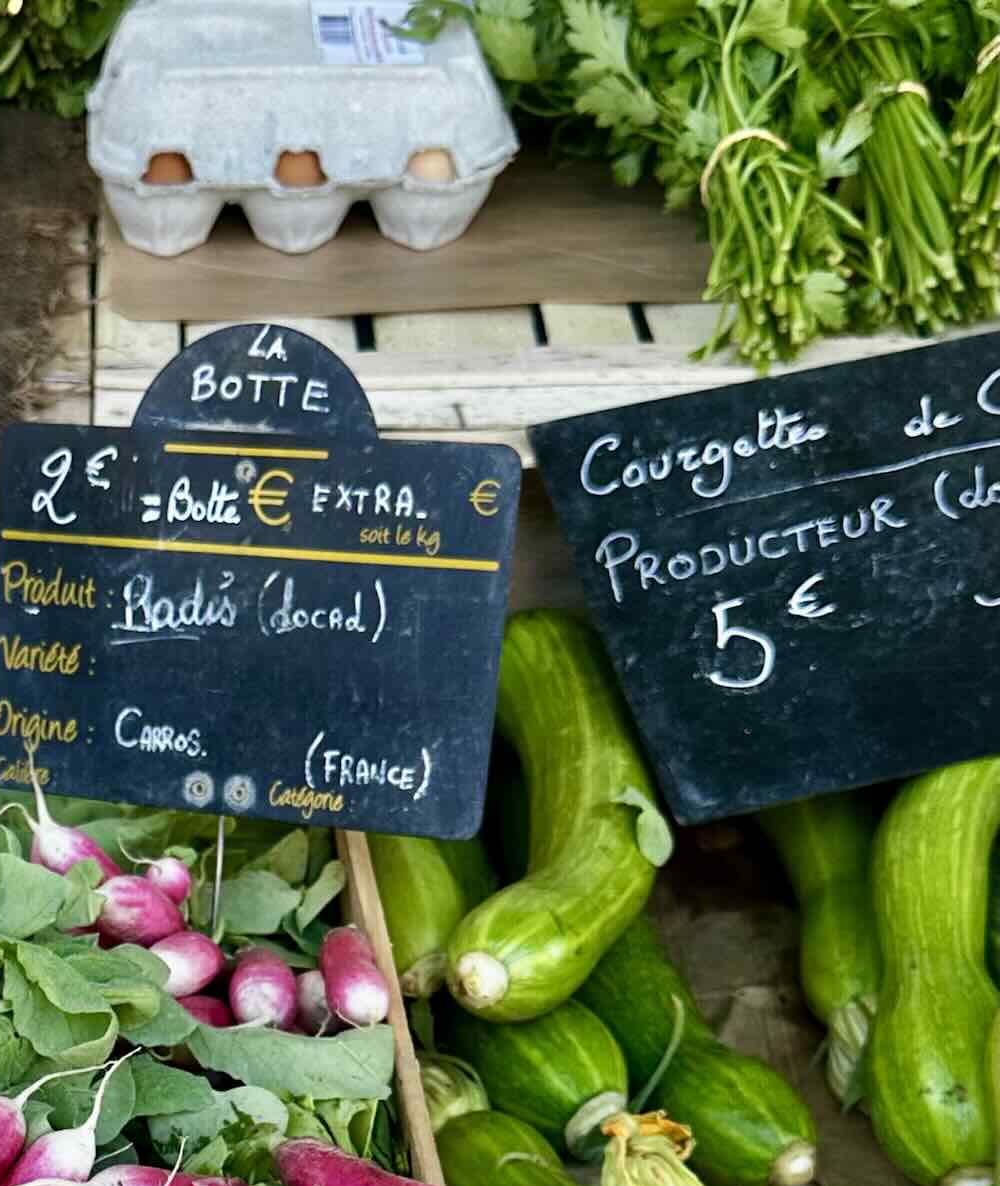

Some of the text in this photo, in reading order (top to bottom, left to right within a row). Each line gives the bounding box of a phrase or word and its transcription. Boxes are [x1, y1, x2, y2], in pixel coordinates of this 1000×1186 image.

[190, 363, 332, 414] BOTTE
[903, 395, 965, 438] de
[359, 524, 441, 557] soit le kg
[594, 494, 910, 604] PRODUCTEUR
[303, 730, 432, 801] (FRANCE)
